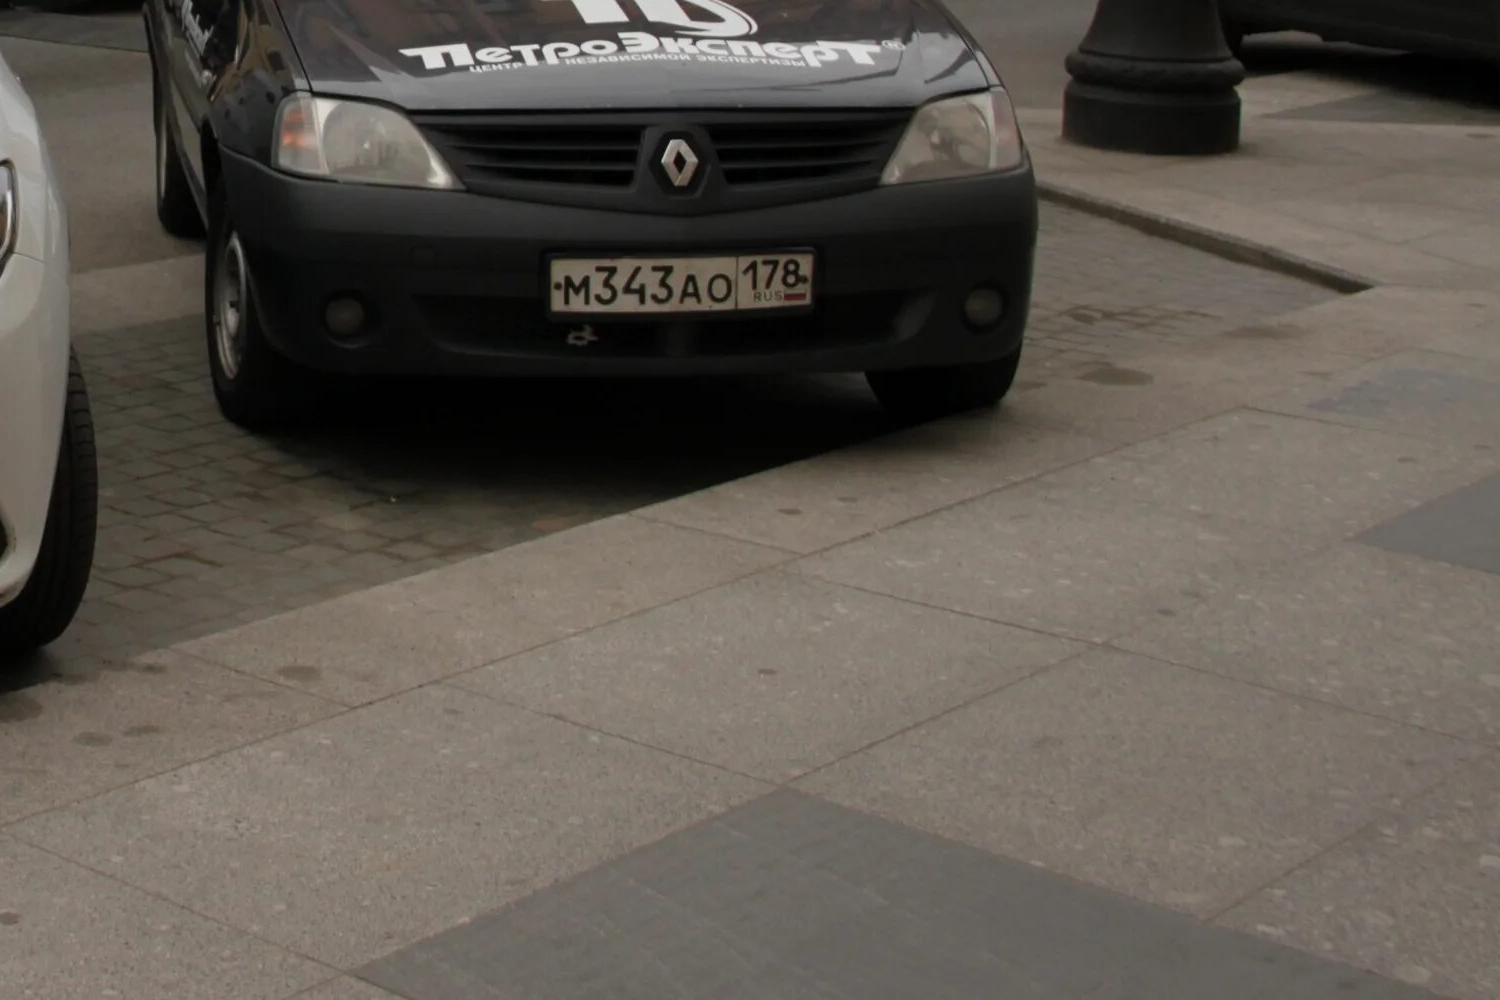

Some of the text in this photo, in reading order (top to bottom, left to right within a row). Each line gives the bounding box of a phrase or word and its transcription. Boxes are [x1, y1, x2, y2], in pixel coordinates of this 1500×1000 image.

[398, 31, 882, 71] ПетроЭксперт
[469, 51, 807, 74] ЦЕНТР НЕЗАВИСИМОЙ ЭКСПЕРТИЗЫ
[742, 258, 801, 291] 178
[753, 290, 783, 303] RUS
